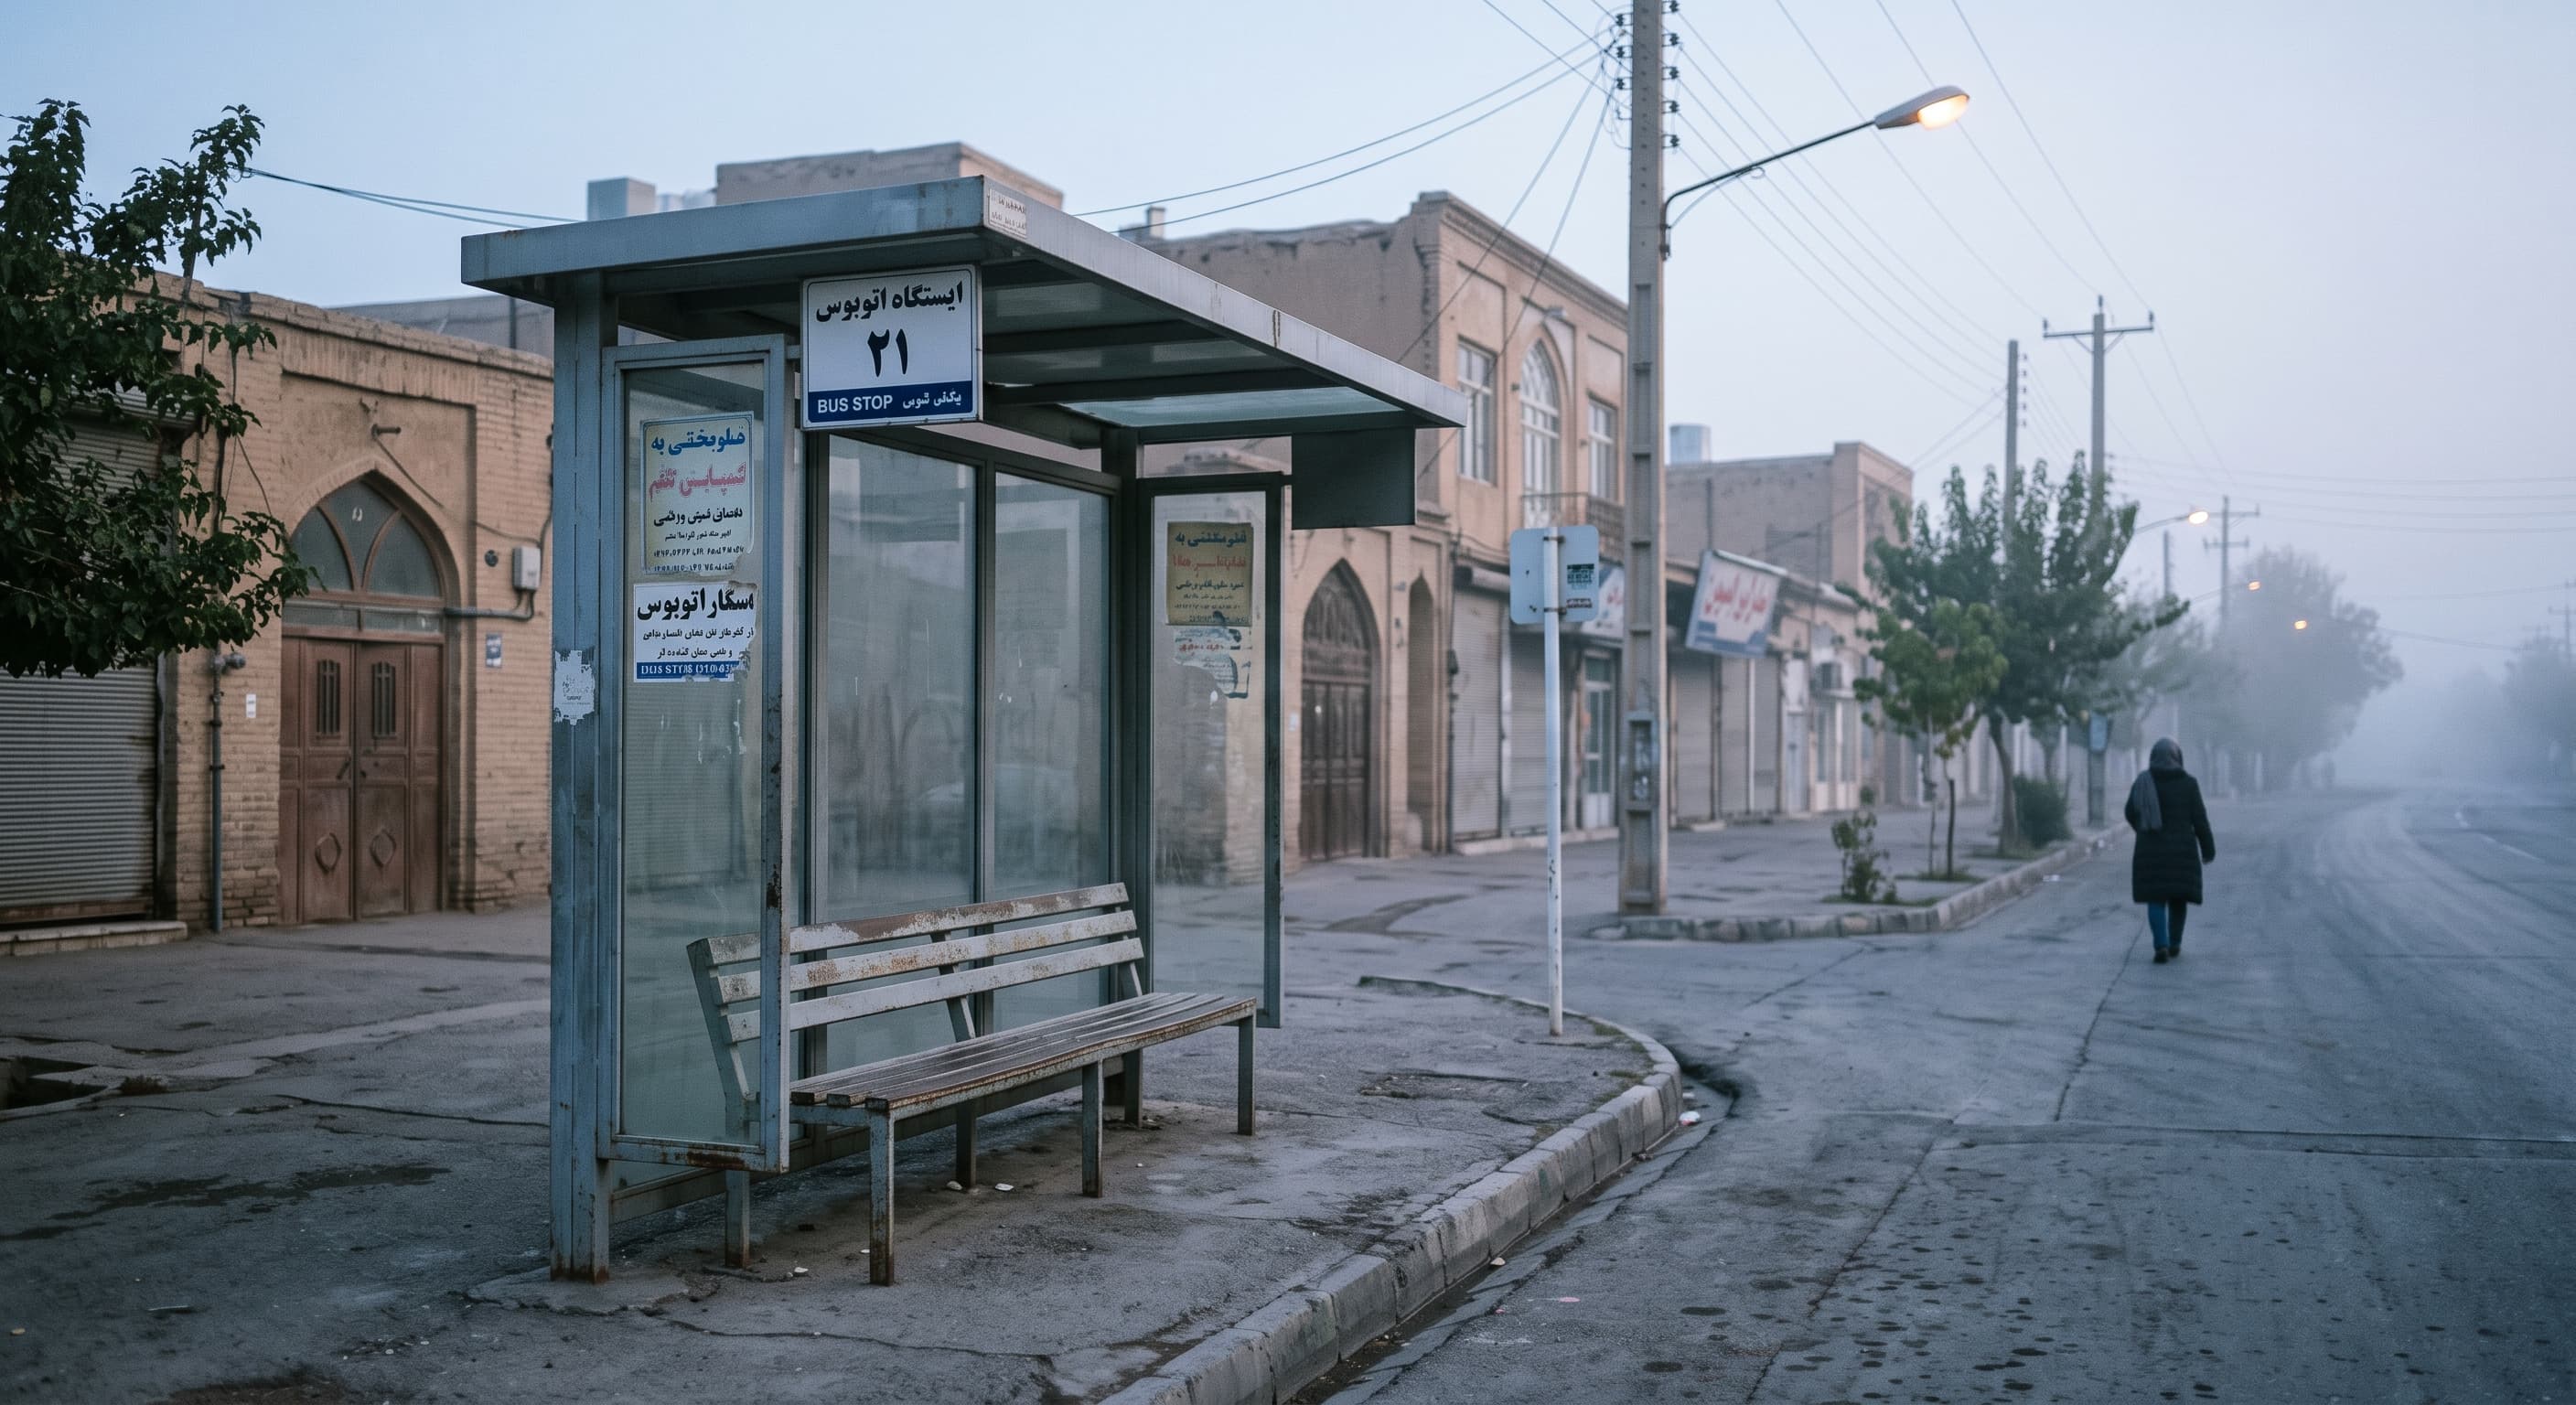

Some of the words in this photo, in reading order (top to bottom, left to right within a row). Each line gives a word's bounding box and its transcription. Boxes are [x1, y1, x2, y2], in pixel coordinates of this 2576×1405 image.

[816, 286, 886, 322] اتوبوس
[891, 280, 963, 312] ایستگاه
[867, 328, 908, 378] ۲۱
[818, 398, 849, 413] BUS
[853, 395, 893, 412] STOP
[637, 587, 705, 620] اتوبوس
